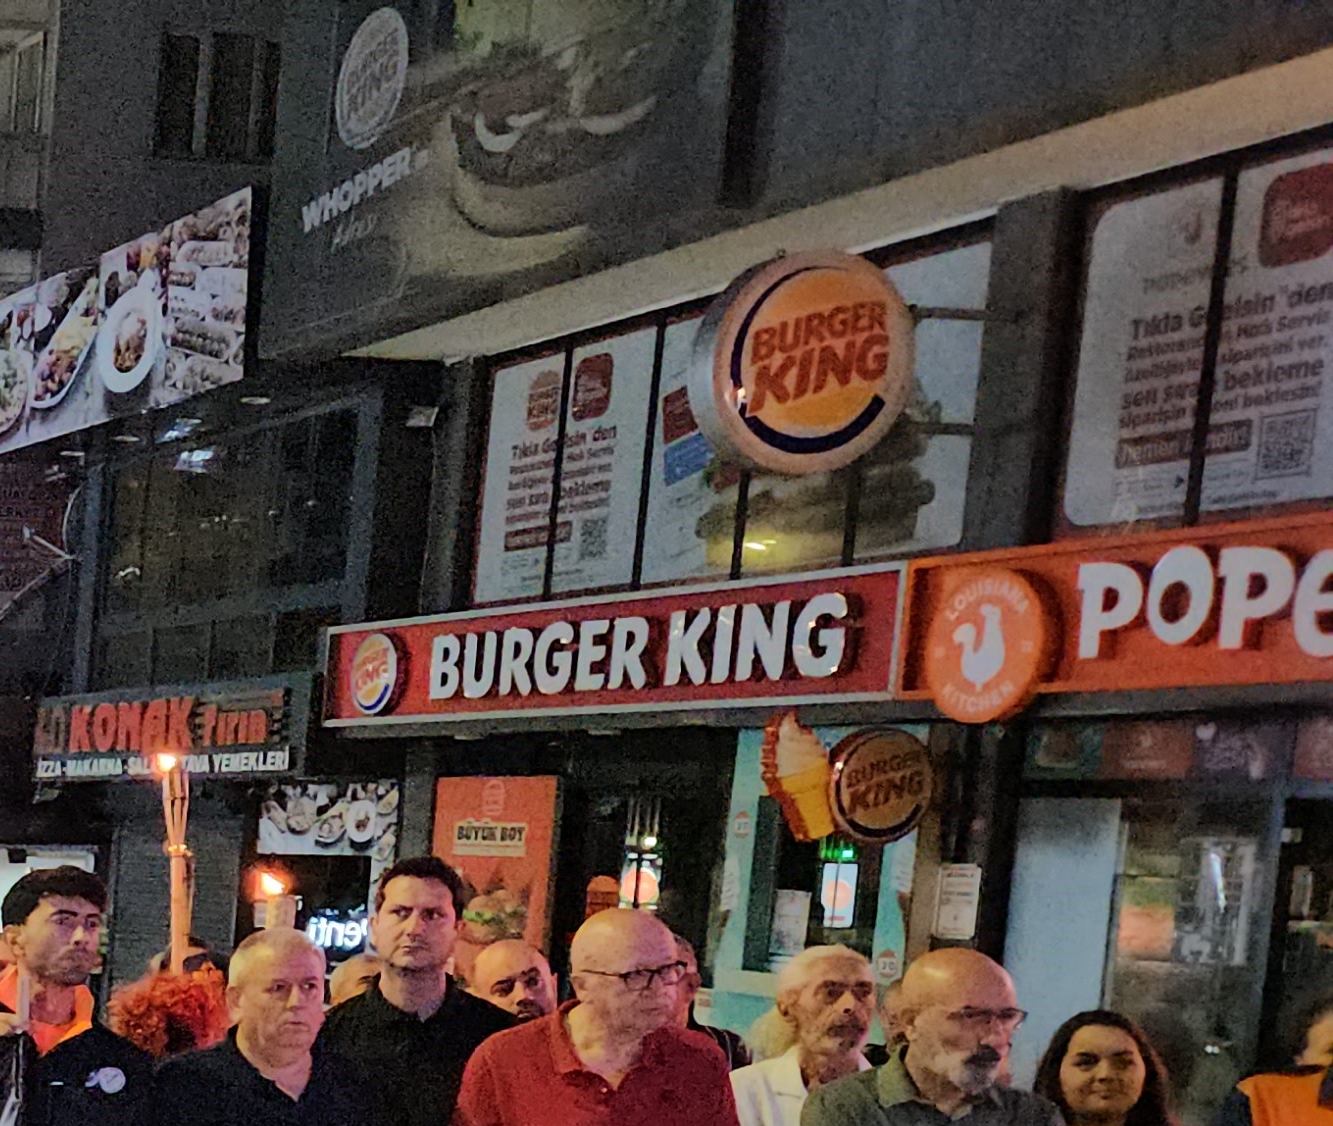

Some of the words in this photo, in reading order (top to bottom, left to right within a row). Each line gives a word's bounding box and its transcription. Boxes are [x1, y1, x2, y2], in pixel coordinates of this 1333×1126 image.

[301, 147, 411, 233] WHOPPER
[751, 301, 886, 366] BURGER
[747, 333, 891, 415] KING
[947, 577, 1031, 622] LOUISIANA
[430, 615, 649, 700] BURGER
[663, 591, 849, 686] KING
[69, 696, 192, 753] KONAK
[941, 679, 1017, 715] KITCHEN
[213, 745, 289, 774] YEMEKLERİ
[500, 826, 526, 842] BOY
